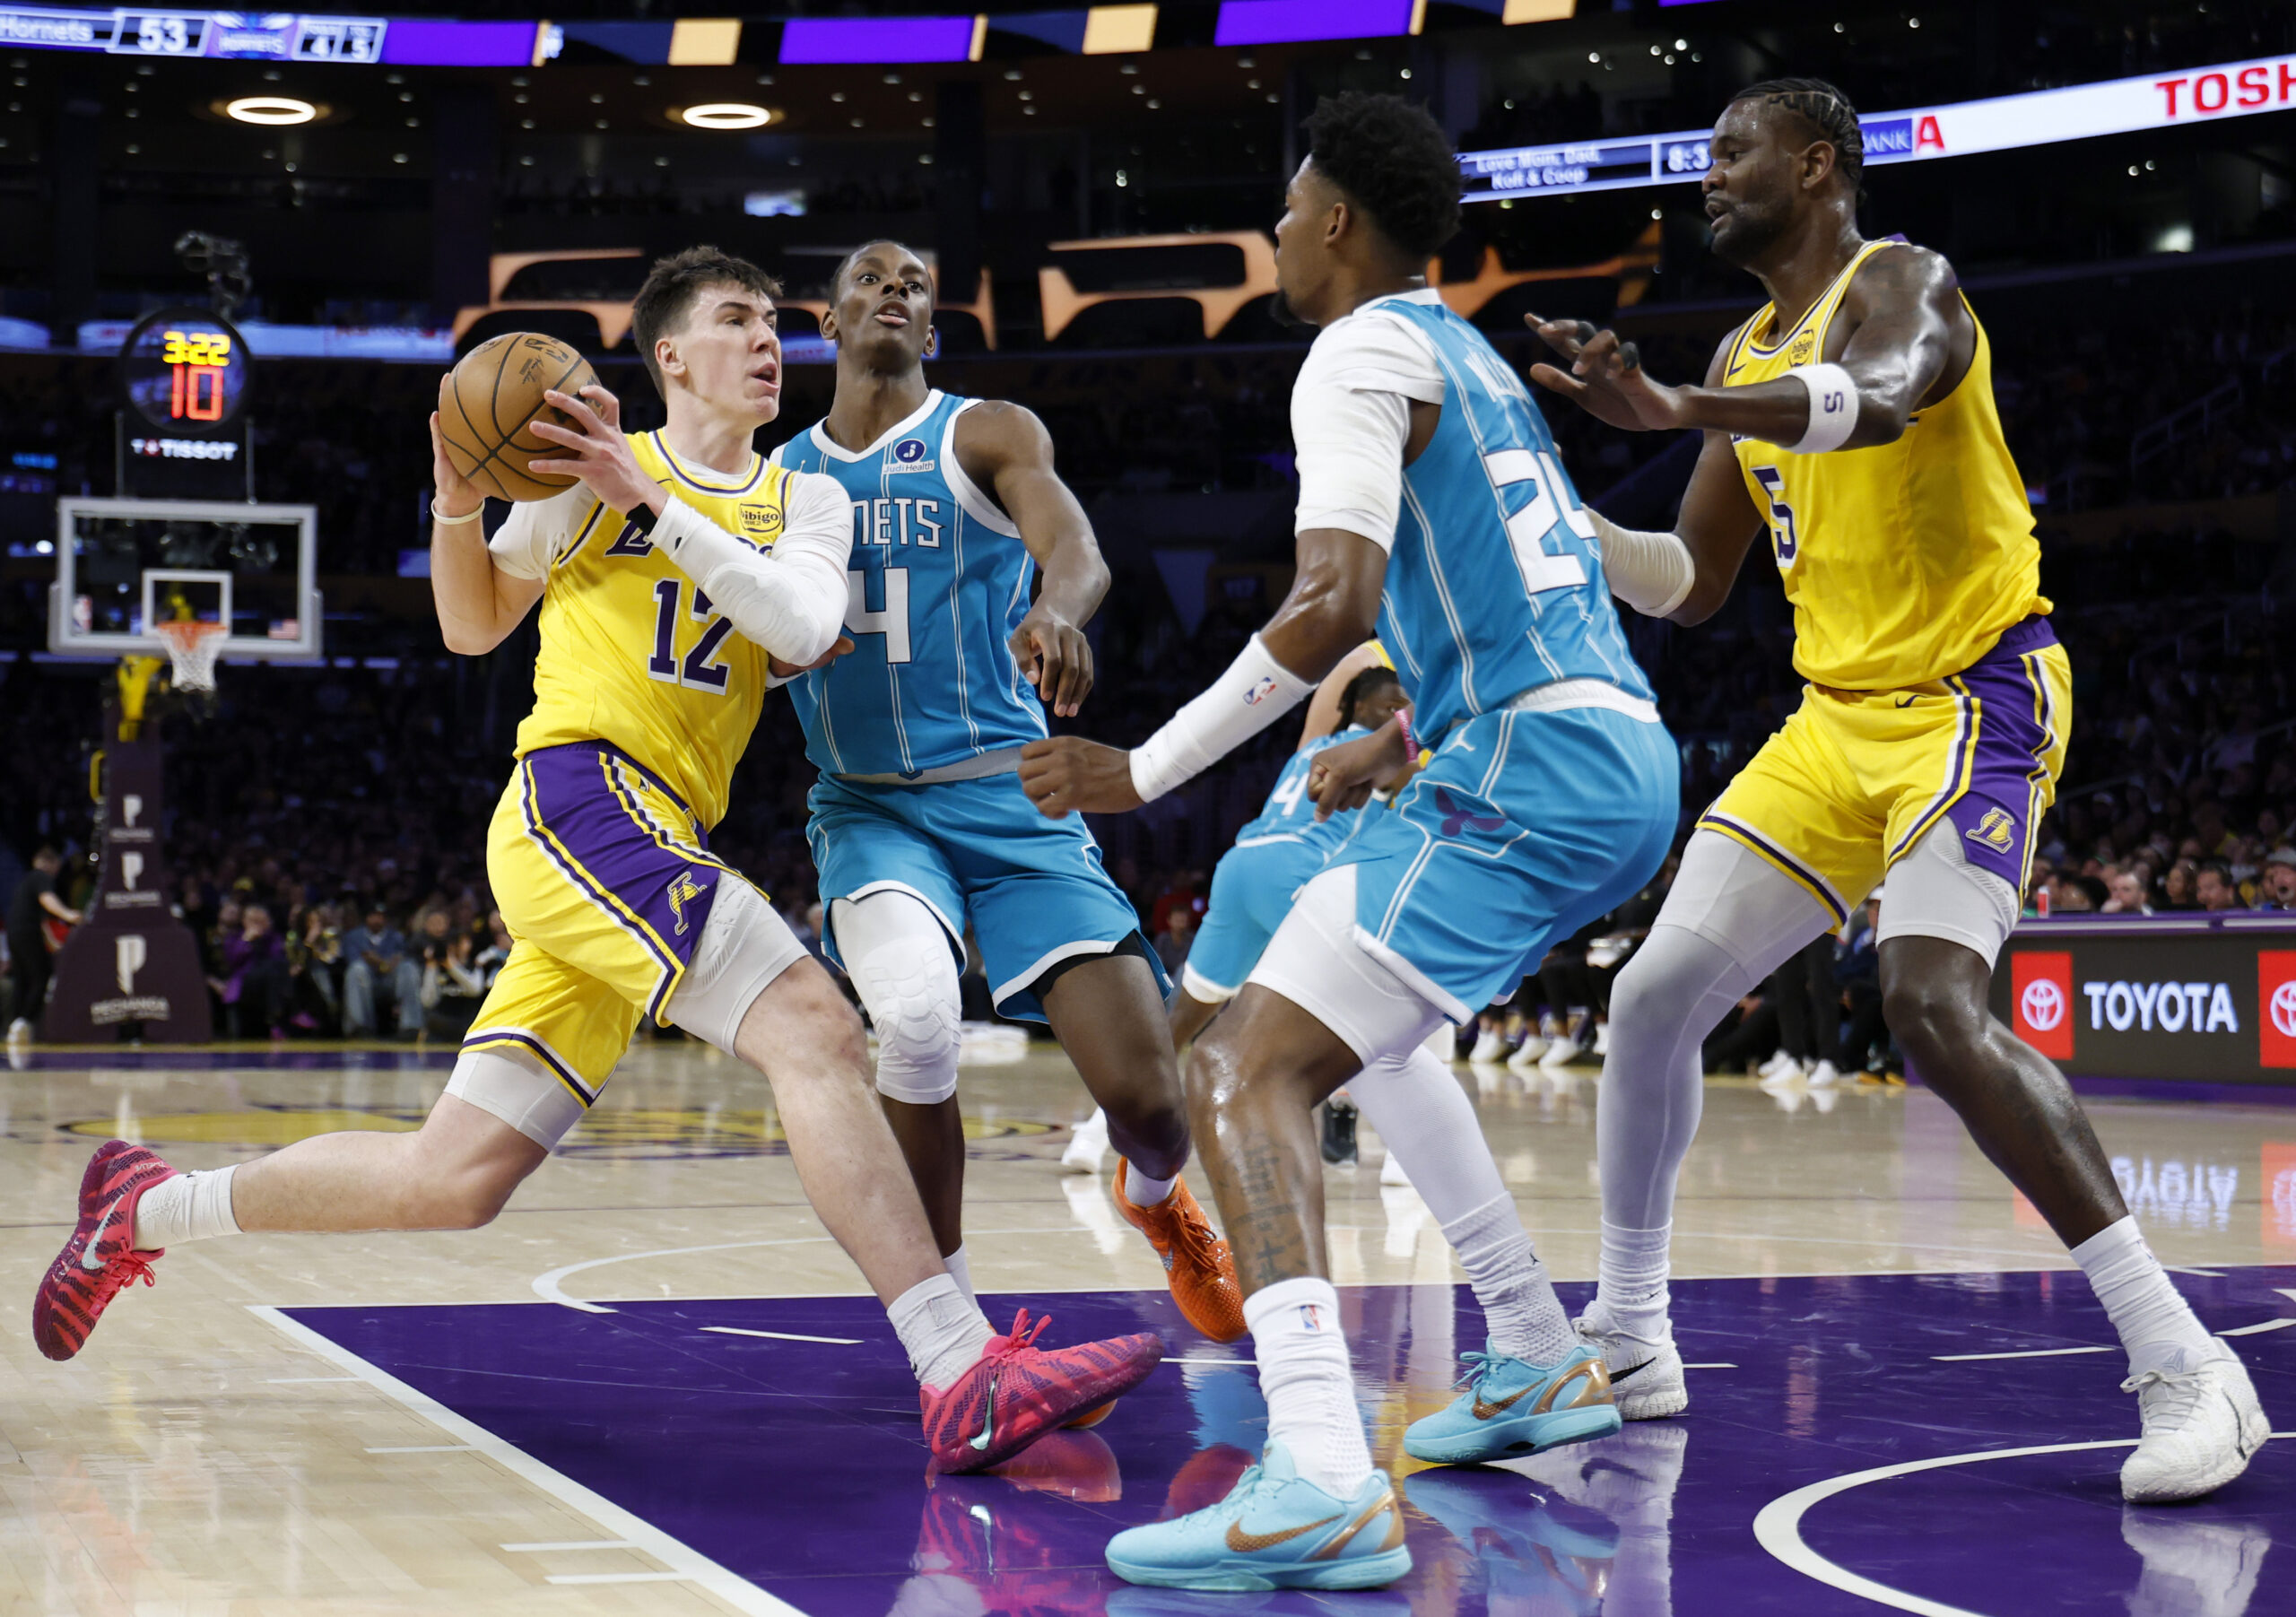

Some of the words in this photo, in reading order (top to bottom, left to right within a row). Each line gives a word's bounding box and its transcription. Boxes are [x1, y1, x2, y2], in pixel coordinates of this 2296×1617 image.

[0, 16, 93, 41] Hornets
[138, 17, 188, 51] 53
[310, 35, 331, 57] 4
[351, 37, 370, 60] 5
[1668, 143, 1712, 172] 8:3
[162, 331, 230, 366] 3:22
[171, 364, 223, 421] 10
[160, 439, 238, 461] TISSOT
[906, 461, 934, 473] Health
[852, 497, 946, 549] NETS
[1750, 465, 1798, 569] 5
[648, 577, 731, 696] 12
[2083, 980, 2239, 1032] TOYOTA
